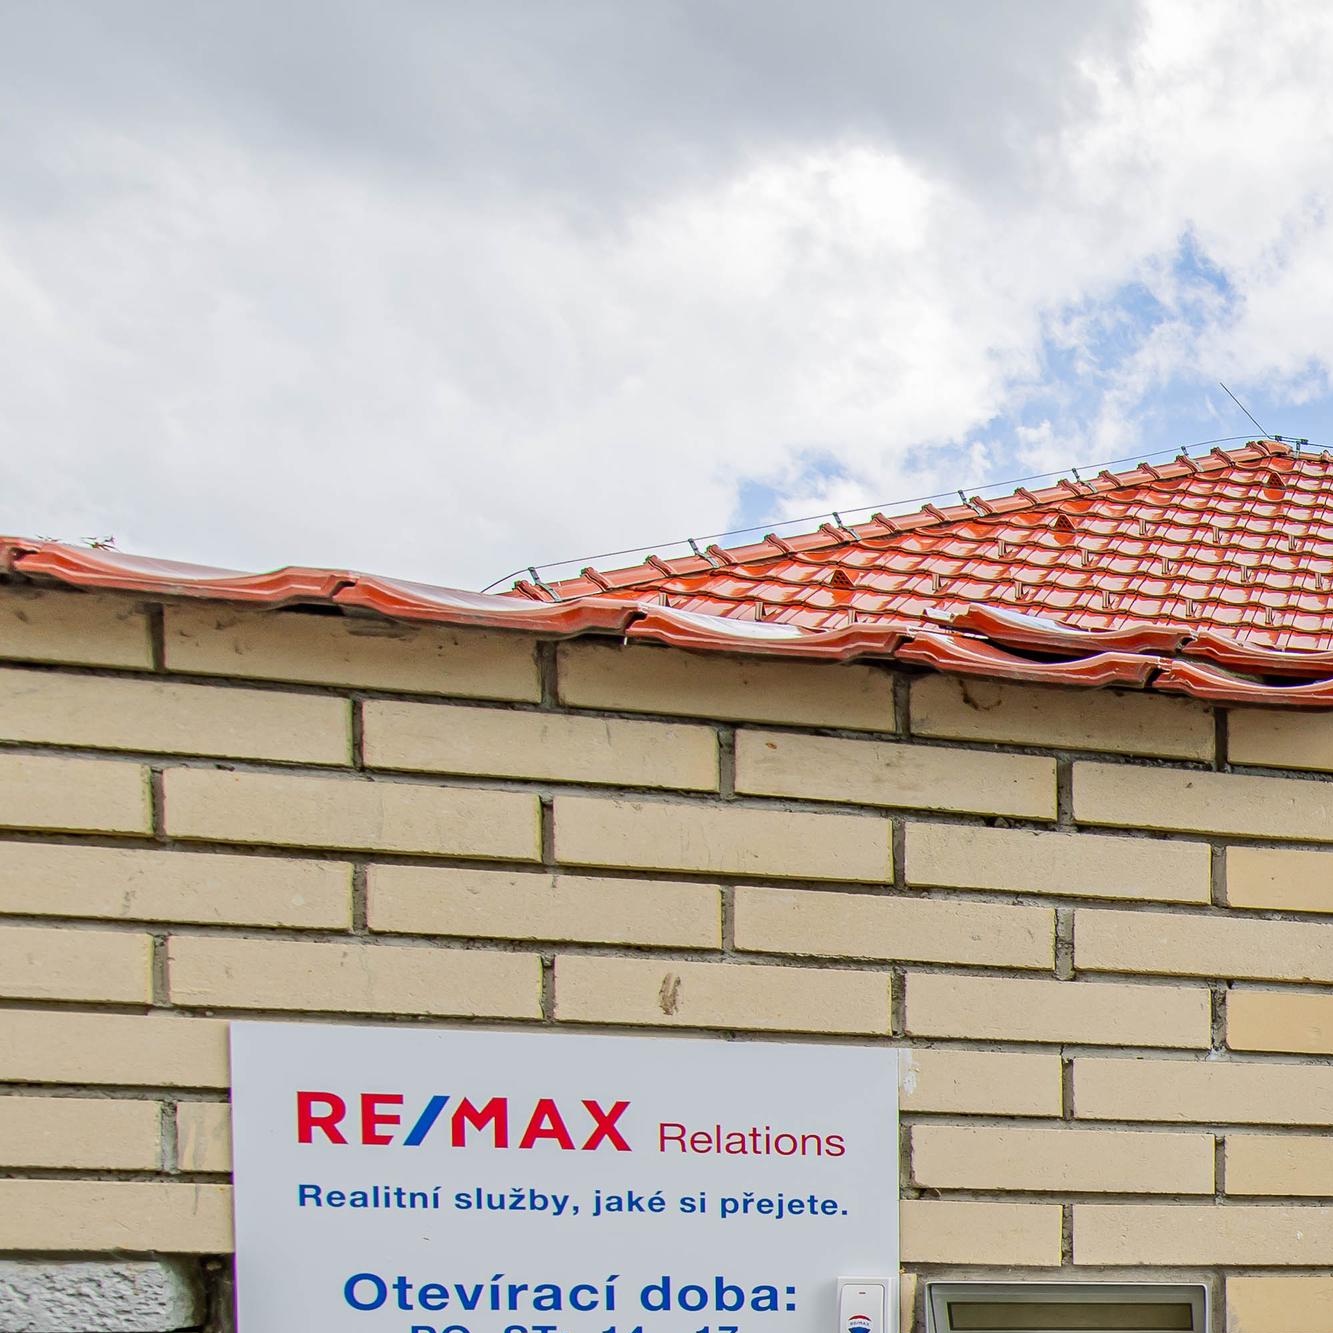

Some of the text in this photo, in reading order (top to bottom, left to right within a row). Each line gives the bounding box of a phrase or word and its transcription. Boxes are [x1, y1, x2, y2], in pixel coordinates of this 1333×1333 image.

[296, 1090, 847, 1157] RE/MAX Relations
[298, 1183, 849, 1220] Realitní služby, jaké si přejete.
[342, 1272, 797, 1313] Otevírací doba:
